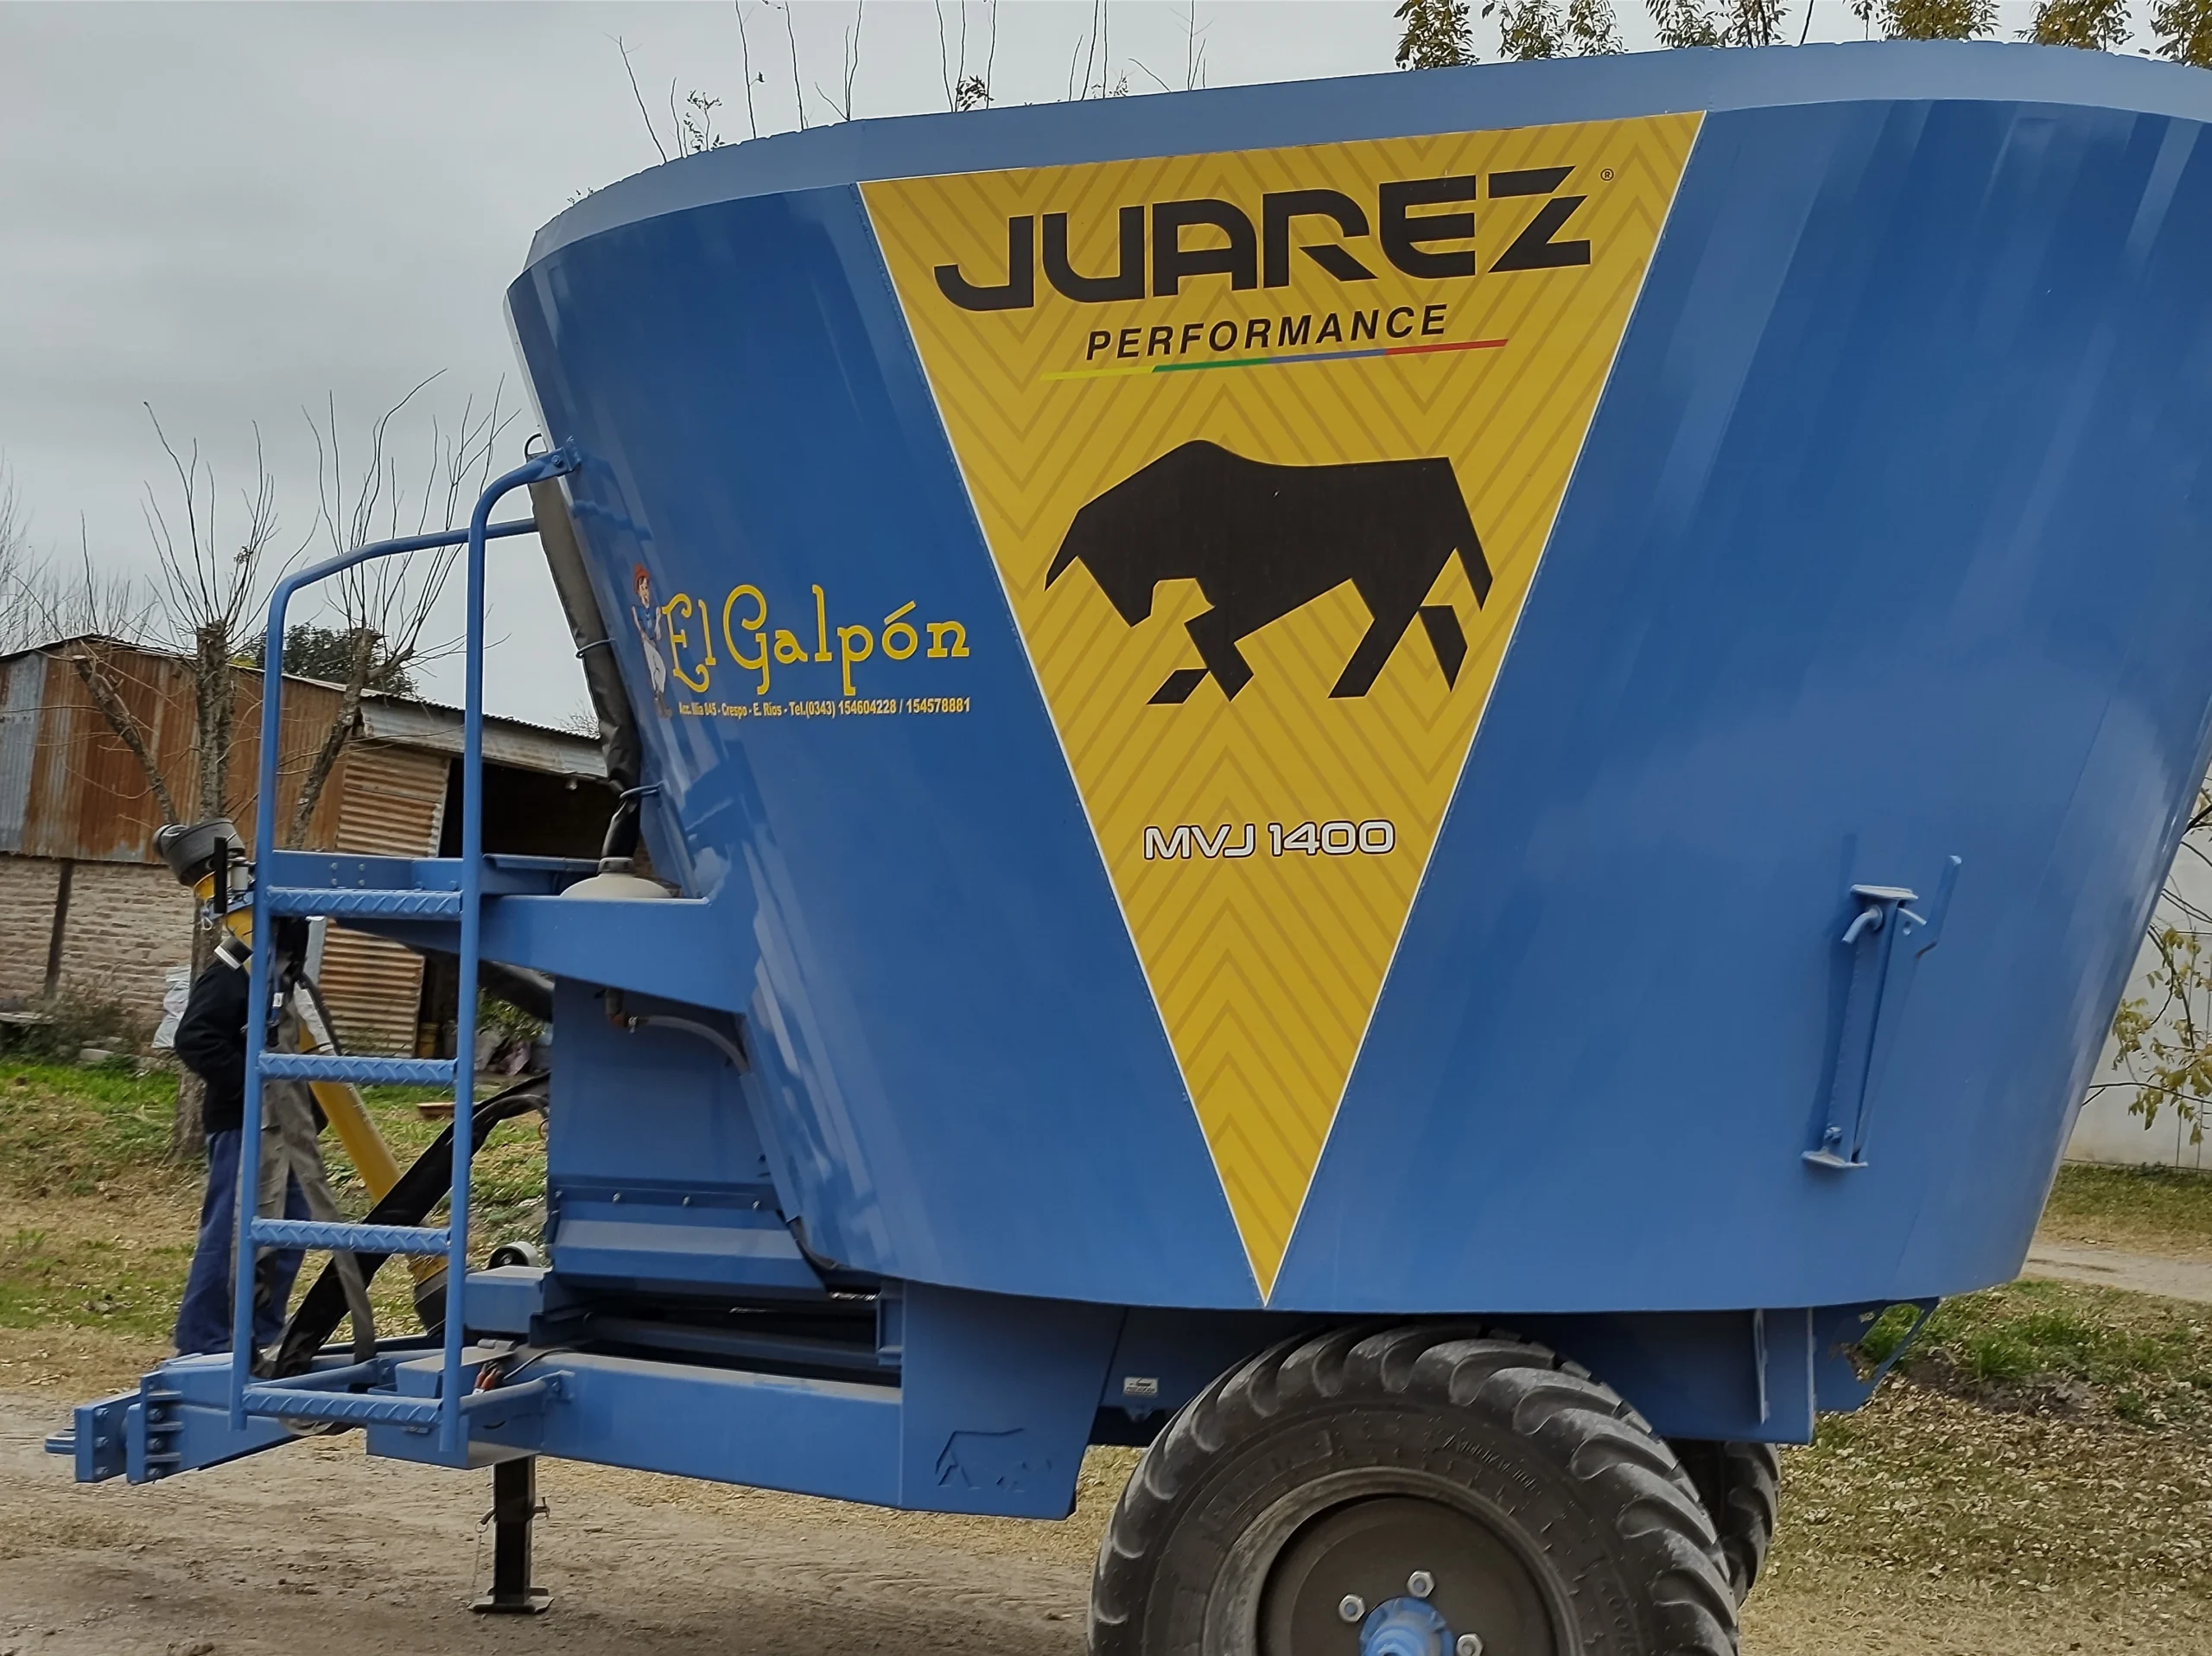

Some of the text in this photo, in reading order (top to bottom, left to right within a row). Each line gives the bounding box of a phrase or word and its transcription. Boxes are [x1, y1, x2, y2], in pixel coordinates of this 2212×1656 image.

[933, 165, 1591, 311] JUAREZ
[1086, 303, 1447, 360] PERFORMANCE
[662, 584, 969, 696] El Galpón
[721, 703, 747, 720] Crespo
[838, 699, 896, 715] 154604228
[906, 697, 970, 714] 154578881
[1144, 819, 1395, 860] MVJ 1400
